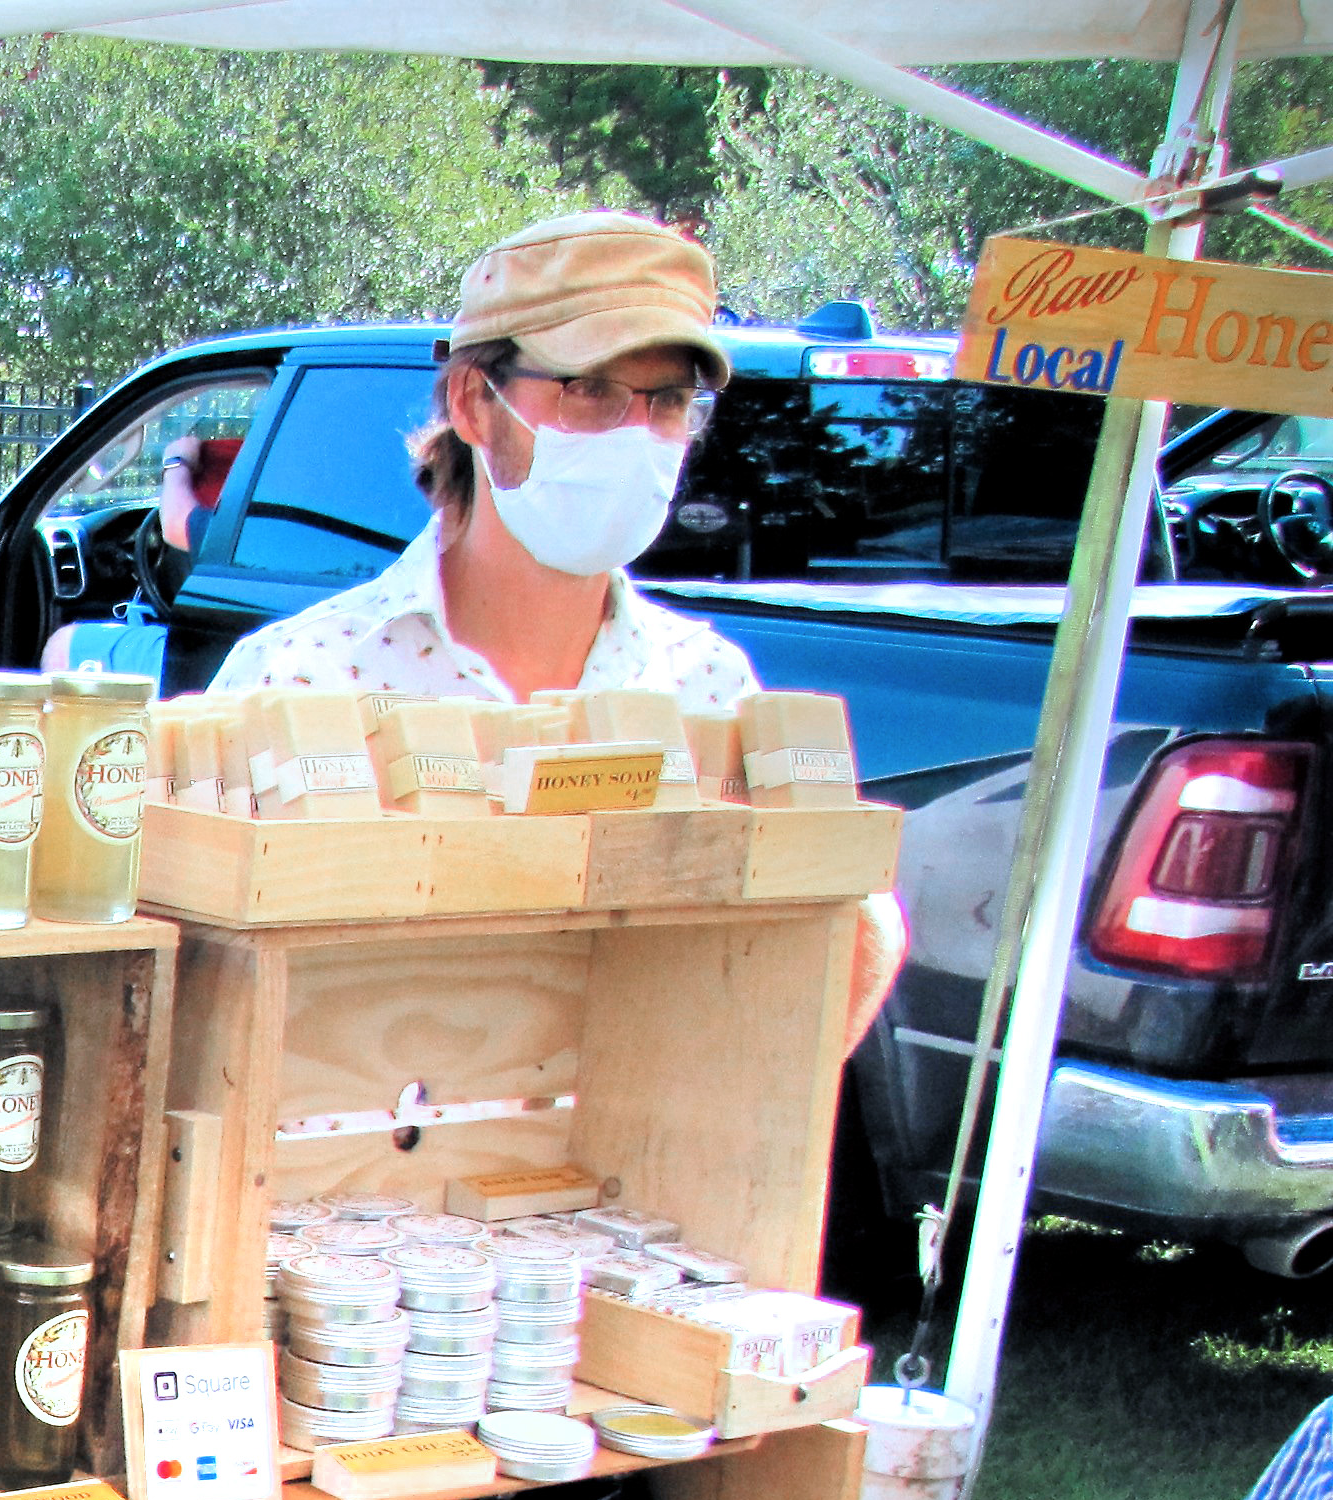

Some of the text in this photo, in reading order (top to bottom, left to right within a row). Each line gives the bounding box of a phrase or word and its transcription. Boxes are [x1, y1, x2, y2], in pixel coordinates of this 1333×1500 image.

[987, 248, 1146, 325] Raw
[1134, 271, 1333, 372] Hone
[984, 327, 1125, 393] Local
[303, 757, 357, 775] HONEY
[536, 769, 656, 791] HONEY SOAP
[185, 1375, 250, 1397] Square
[227, 1417, 255, 1431] VISA
[338, 1438, 473, 1462] BODY CREAM
